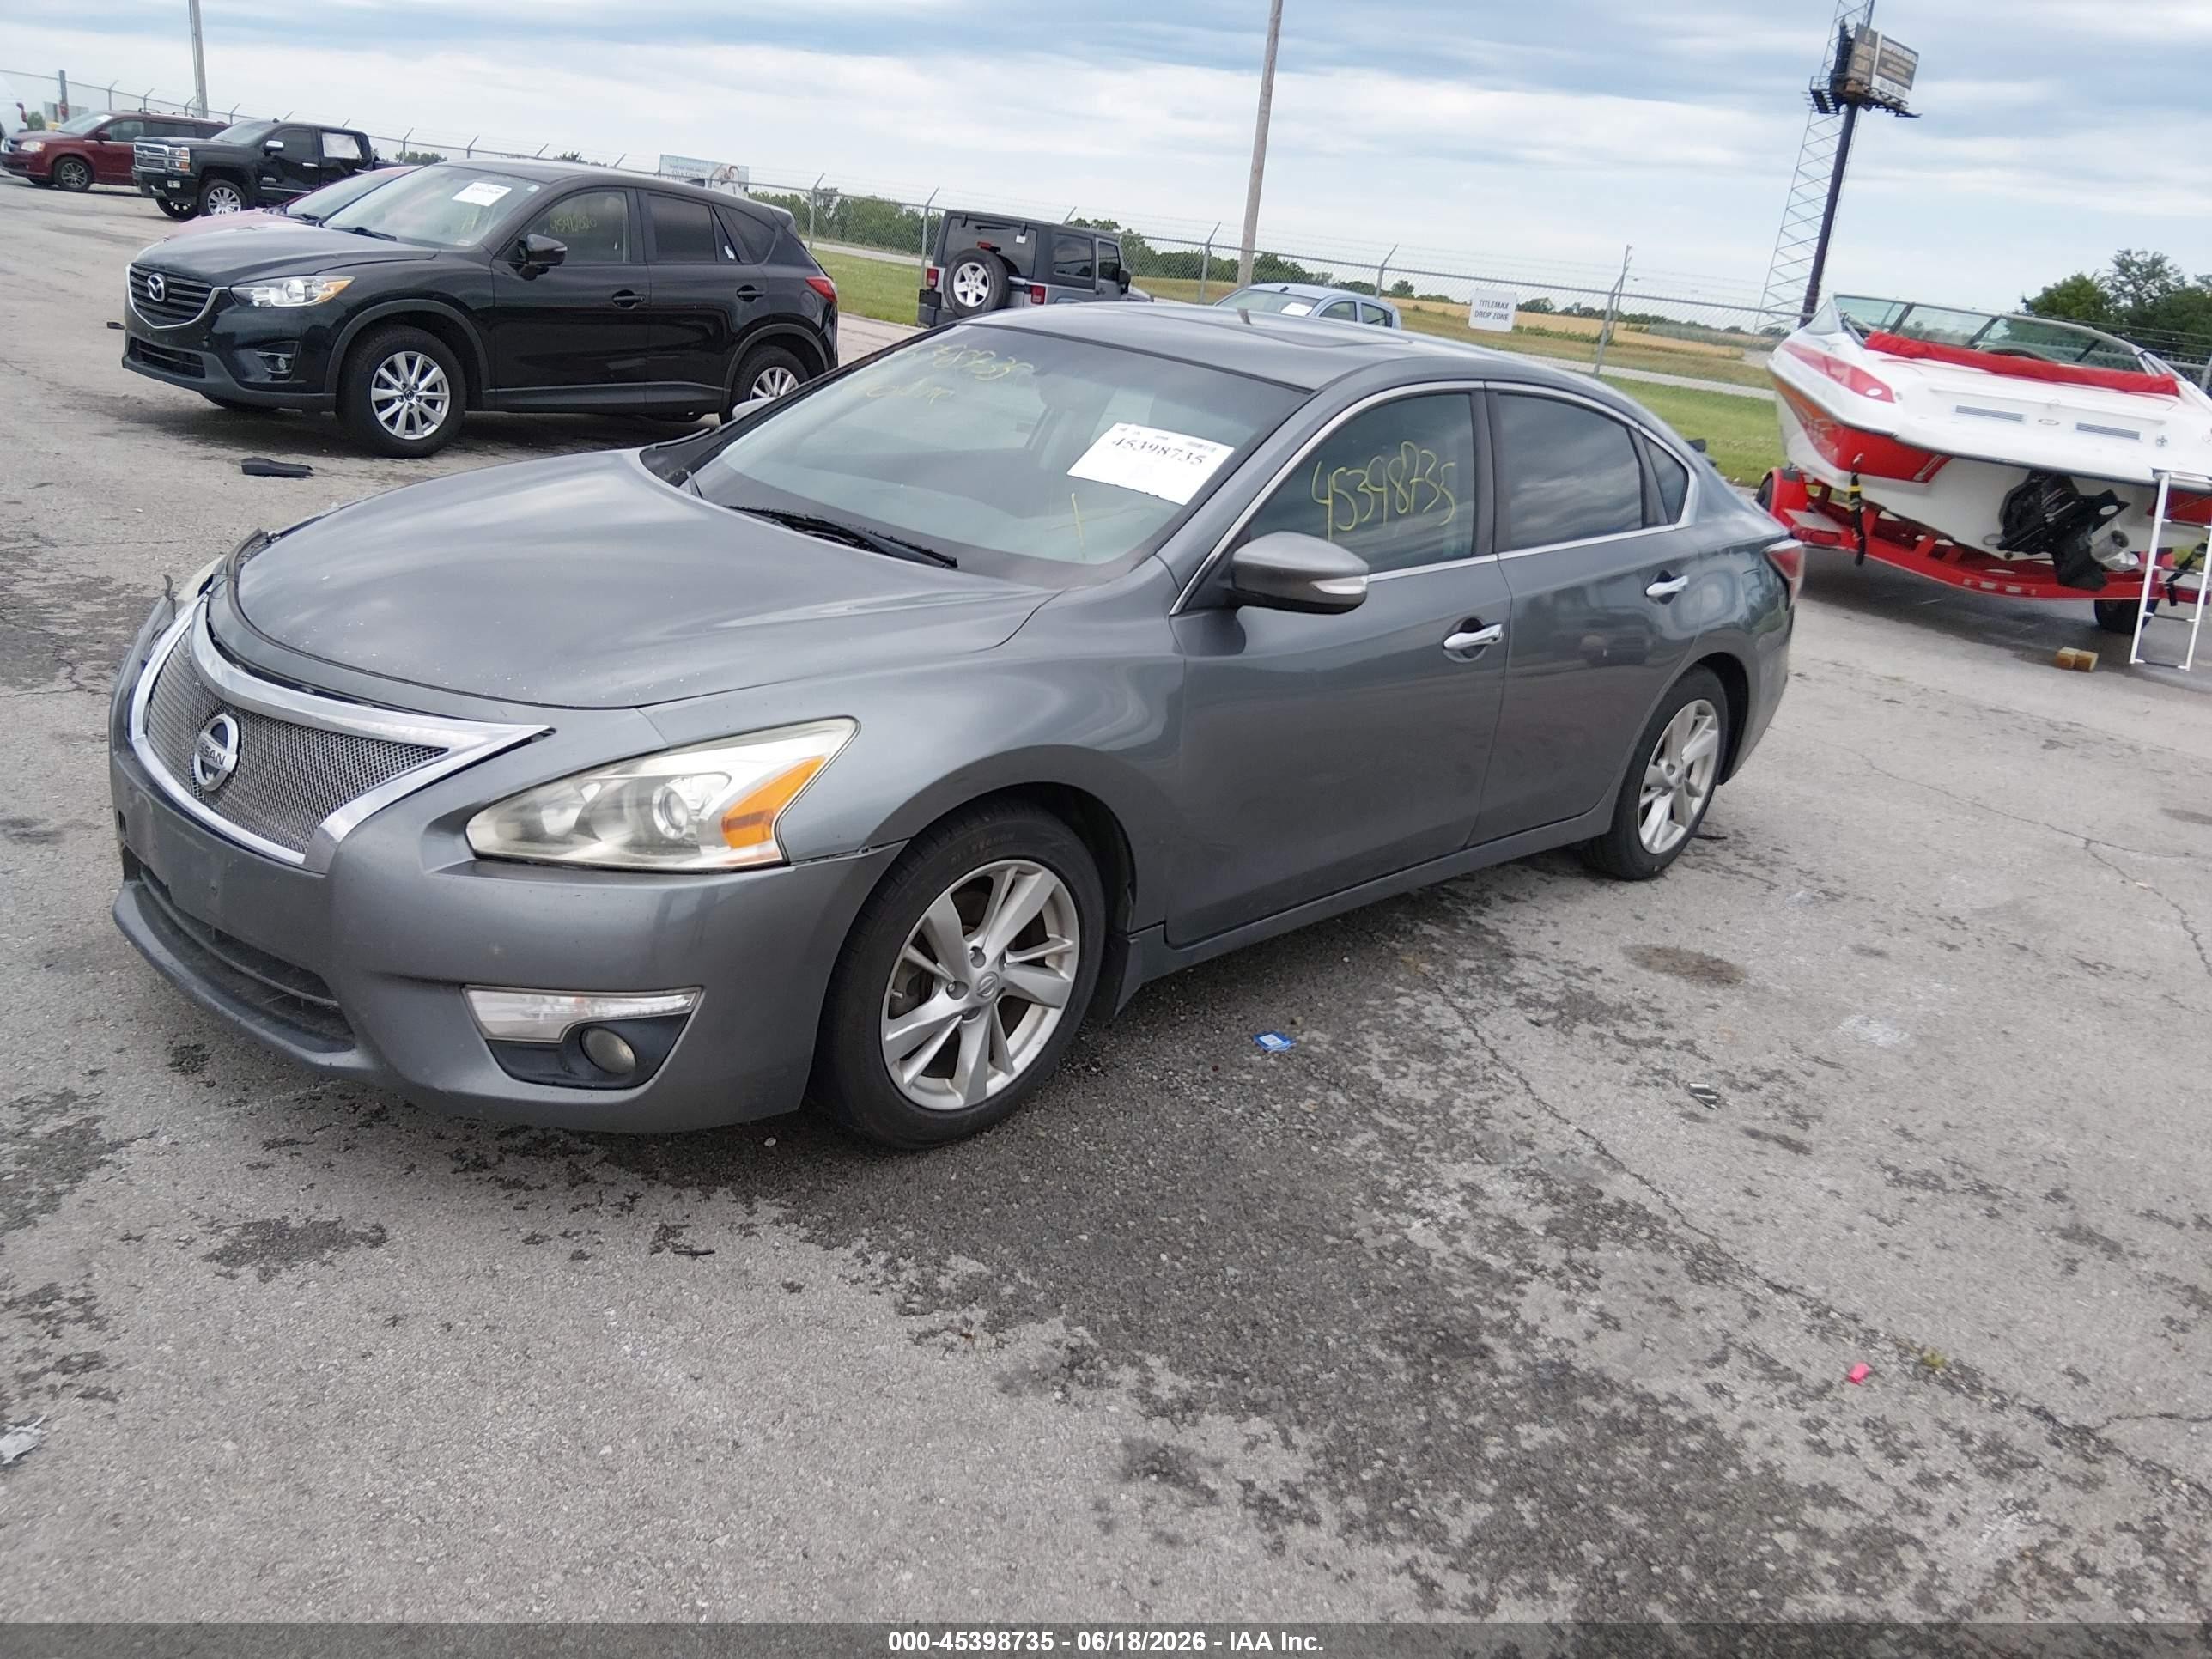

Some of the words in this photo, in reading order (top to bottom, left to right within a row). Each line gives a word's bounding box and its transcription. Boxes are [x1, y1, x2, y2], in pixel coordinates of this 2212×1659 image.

[1474, 310, 1492, 319] DROP
[1492, 313, 1510, 322] ZONE
[1479, 299, 1510, 309] TITLEMAX
[1112, 437, 1207, 466] 45398735
[1311, 441, 1457, 543] 45398735
[197, 739, 227, 766] SSAN
